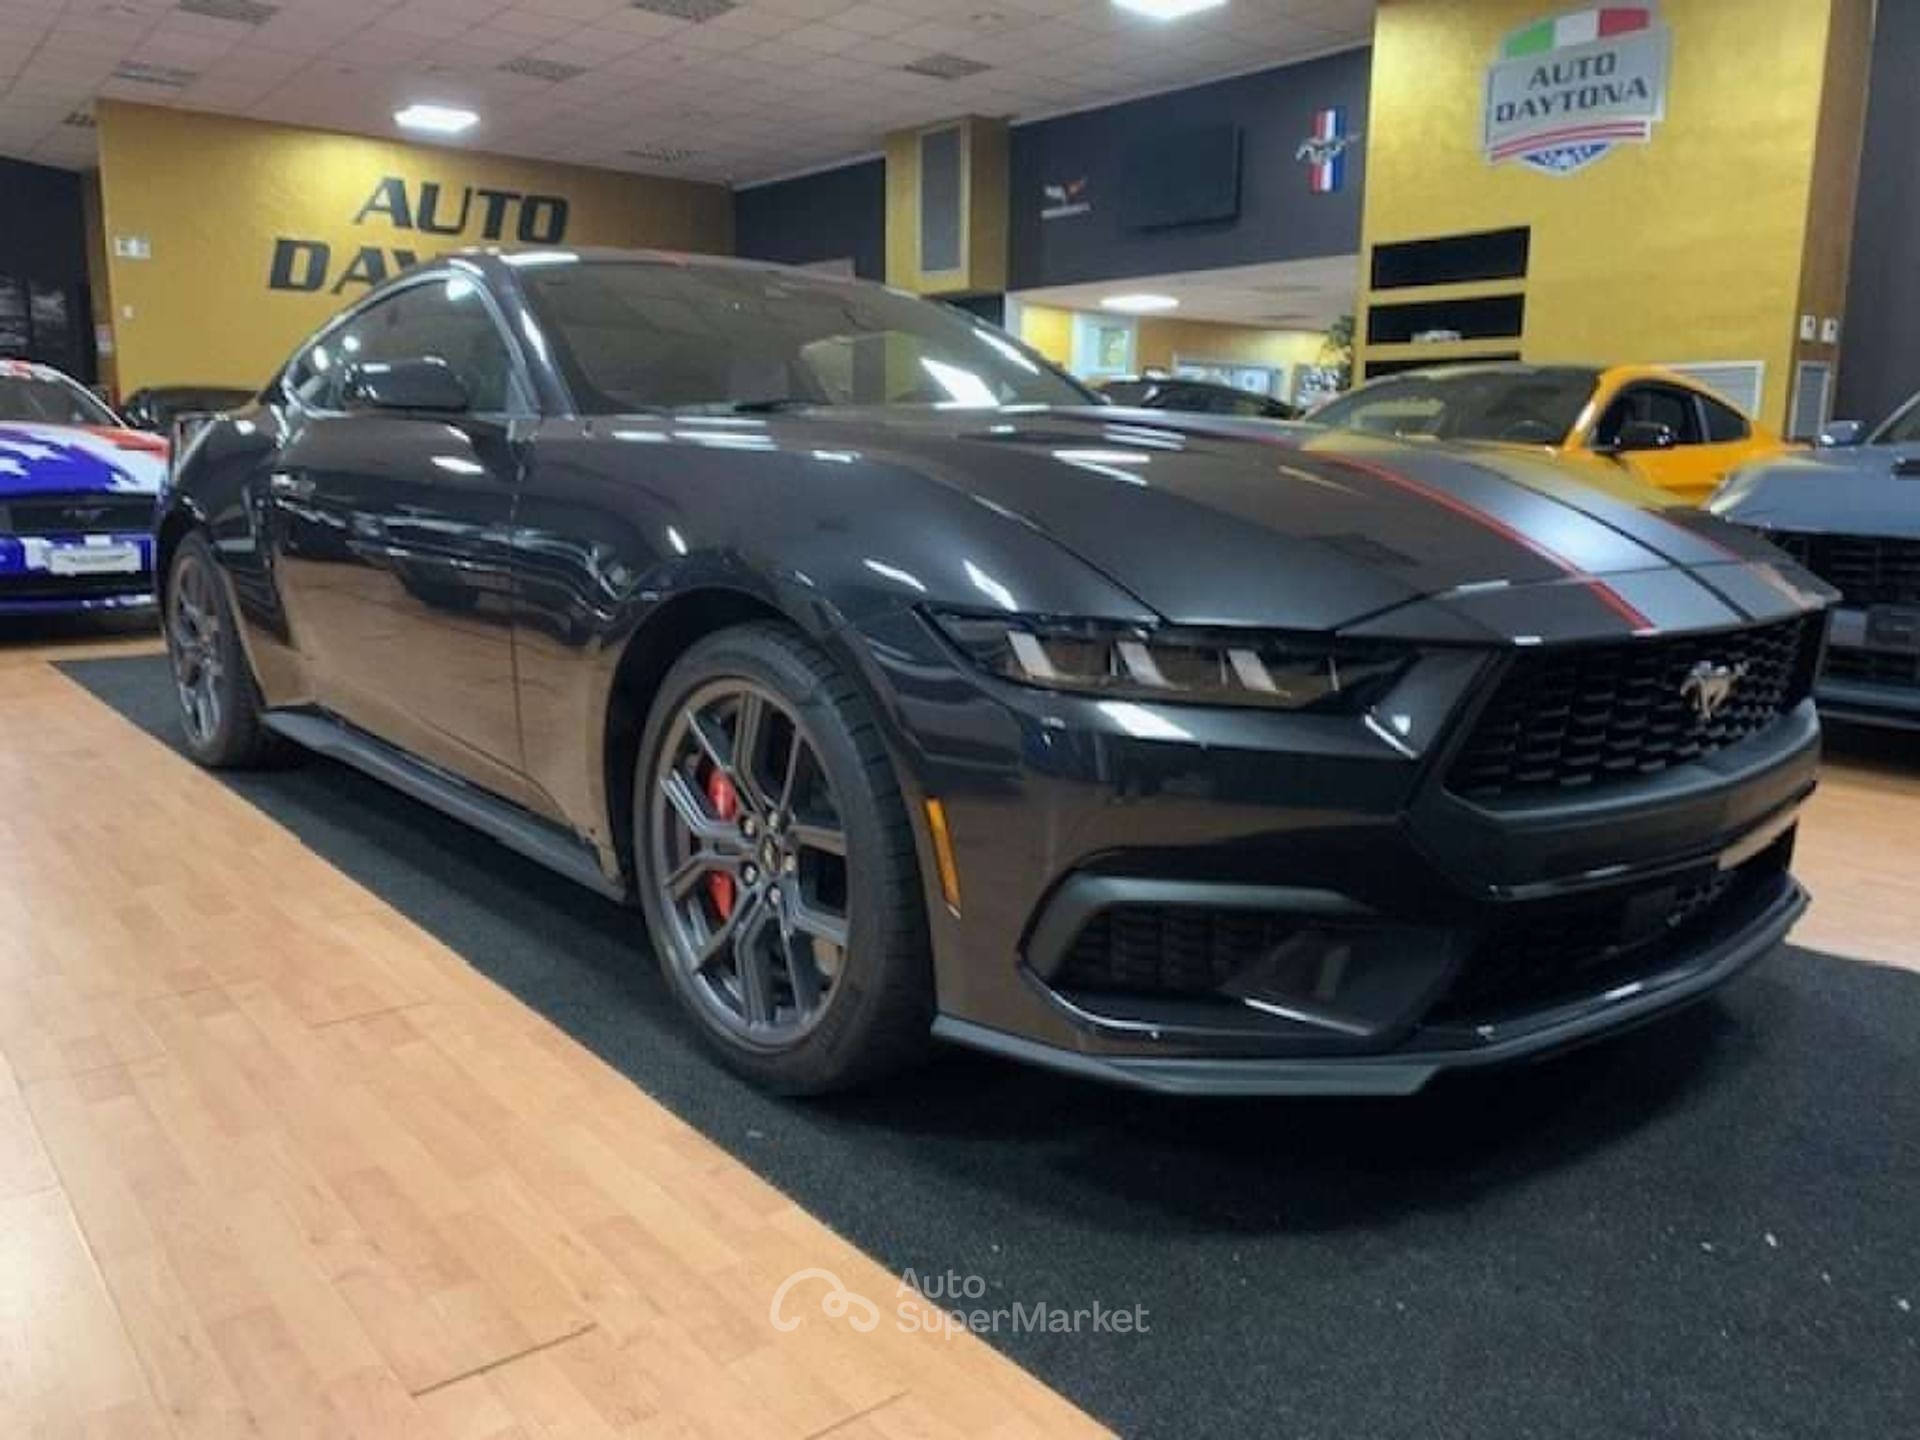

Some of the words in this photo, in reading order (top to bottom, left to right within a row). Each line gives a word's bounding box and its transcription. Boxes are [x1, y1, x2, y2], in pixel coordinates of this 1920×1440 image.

[1529, 52, 1616, 90] AUTO
[1496, 77, 1648, 122] DAYTONA
[354, 176, 569, 244] AUTO
